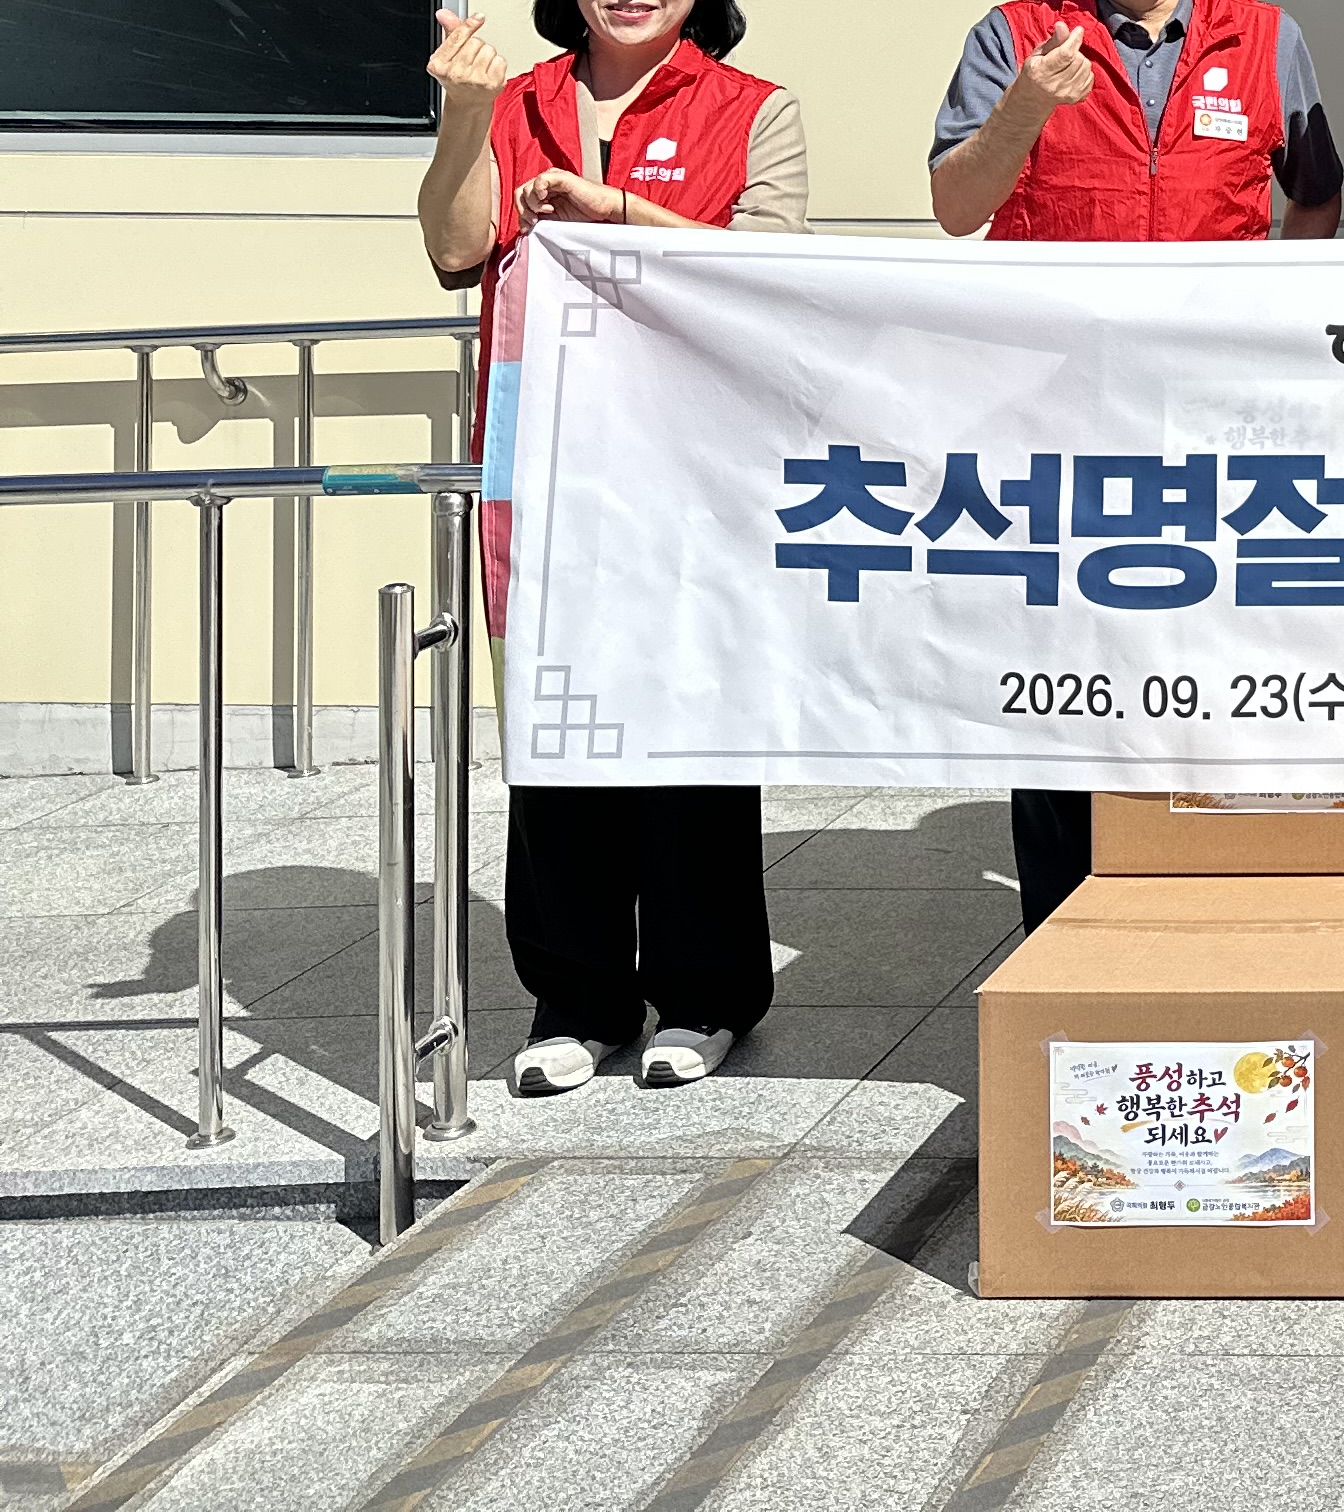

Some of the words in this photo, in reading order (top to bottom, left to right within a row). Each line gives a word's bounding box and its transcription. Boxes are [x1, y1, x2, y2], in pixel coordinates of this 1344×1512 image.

[1192, 96, 1242, 113] 국민의힘
[630, 166, 685, 182] 국민의힘
[1000, 672, 1125, 720] 2026.
[1142, 674, 1211, 720] 09.
[1128, 1063, 1226, 1092] 풍성하고
[1144, 1124, 1213, 1147] 되세요
